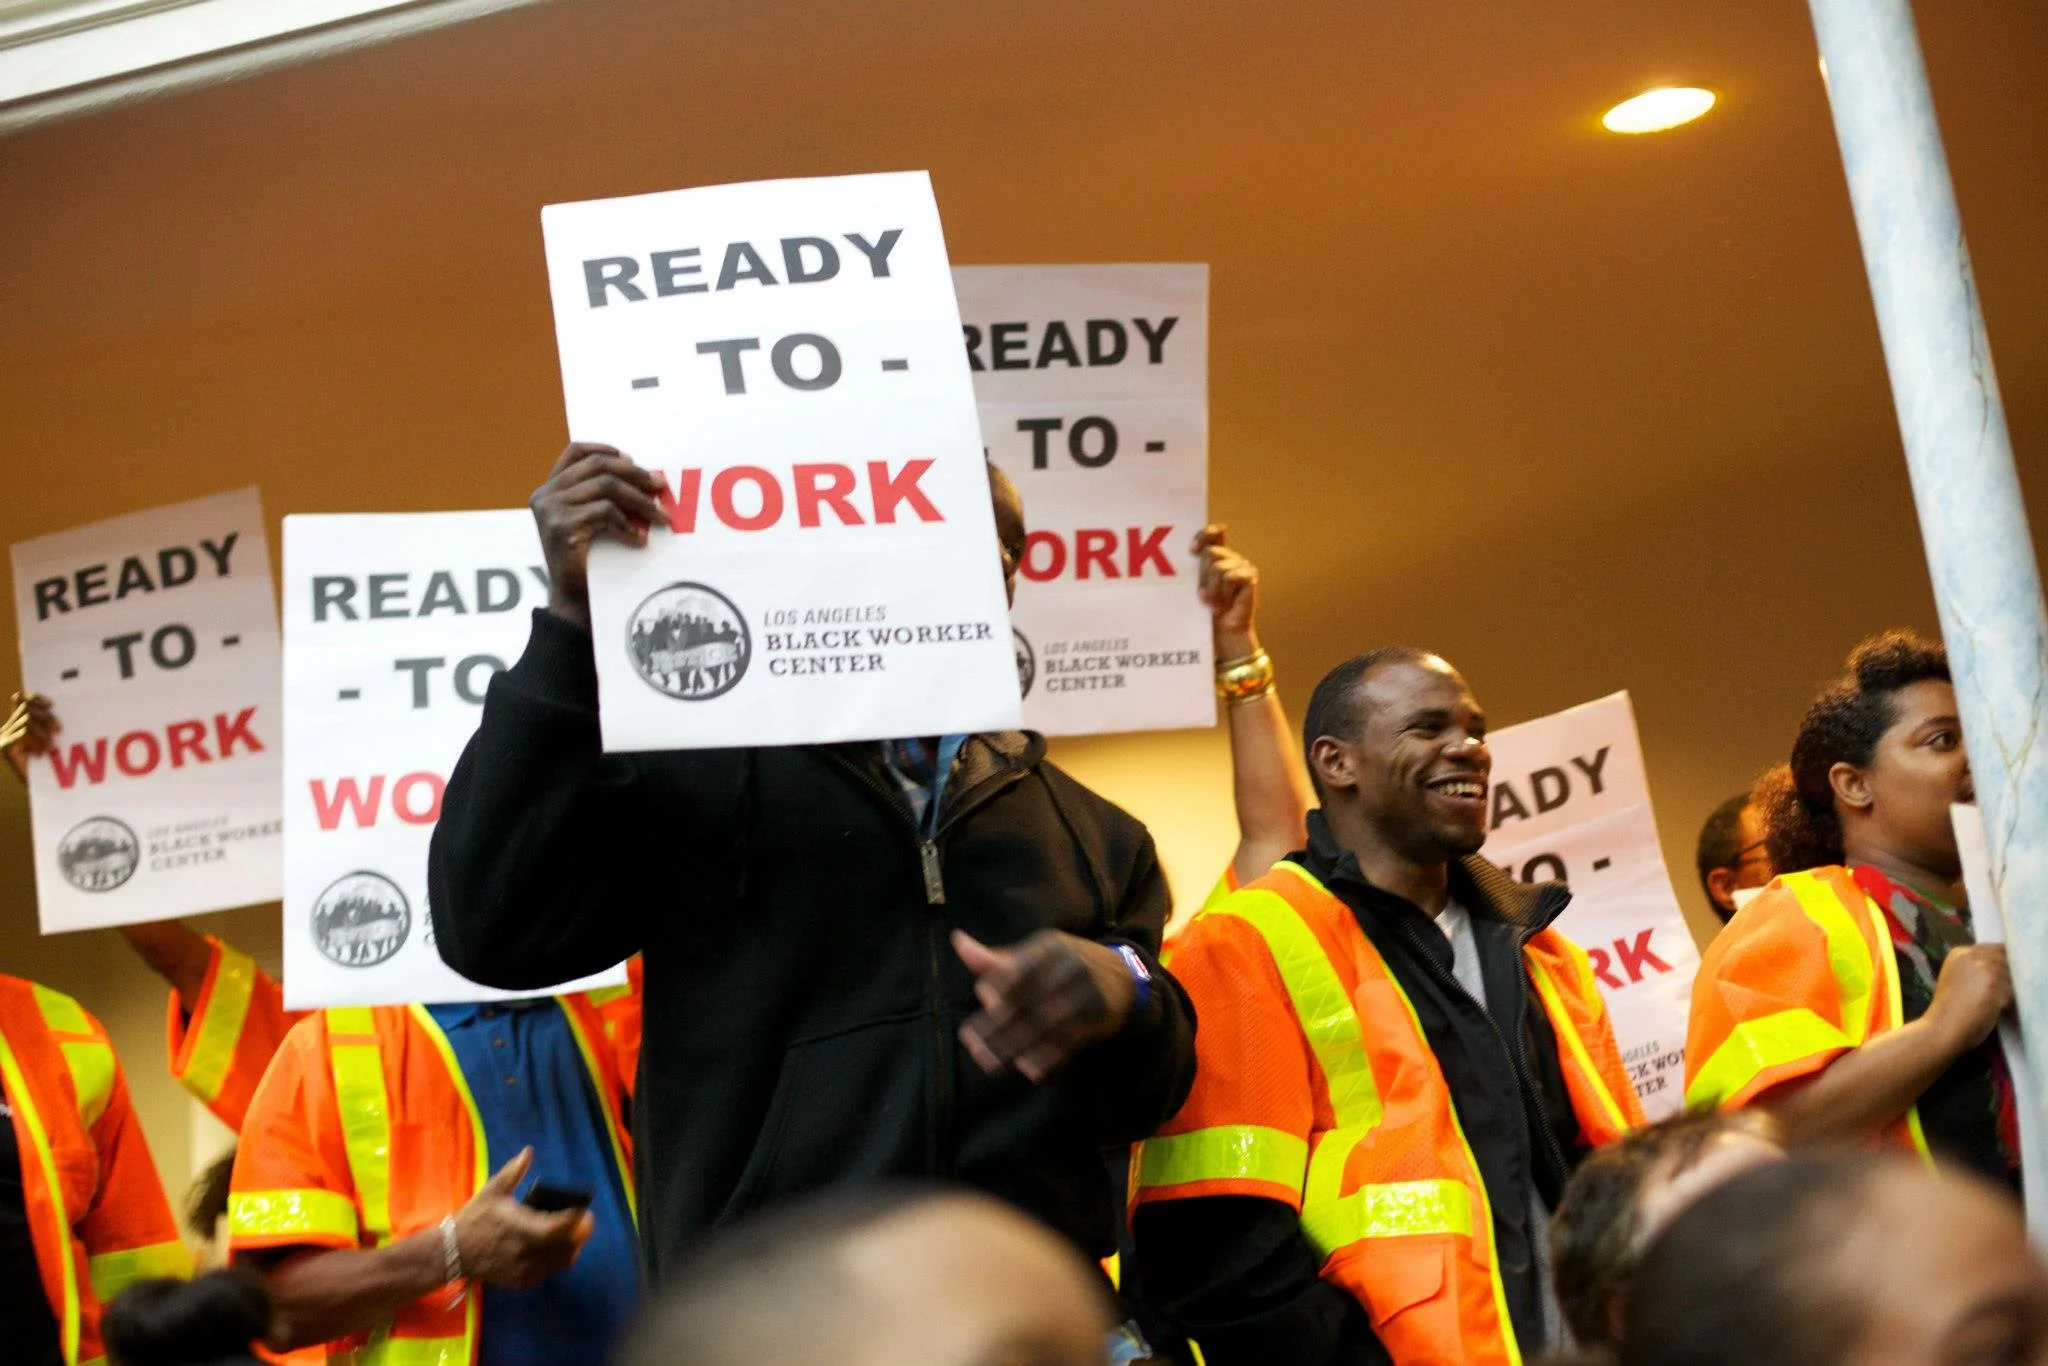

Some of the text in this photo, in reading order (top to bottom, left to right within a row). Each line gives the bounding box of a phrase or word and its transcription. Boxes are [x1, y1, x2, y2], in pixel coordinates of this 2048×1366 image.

[582, 229, 904, 308] READY
[695, 333, 843, 396] TO
[1016, 415, 1119, 470] TO
[33, 531, 240, 622] READY
[1019, 525, 1177, 583] ORK
[762, 604, 887, 628] LOS ANGELES
[765, 621, 995, 652] BLACK WORKER
[101, 622, 198, 680] TO
[767, 652, 888, 677] CENTER
[1045, 650, 1202, 675] BLACK WORKER
[1045, 674, 1127, 693] CENTER
[50, 705, 265, 790] WORK
